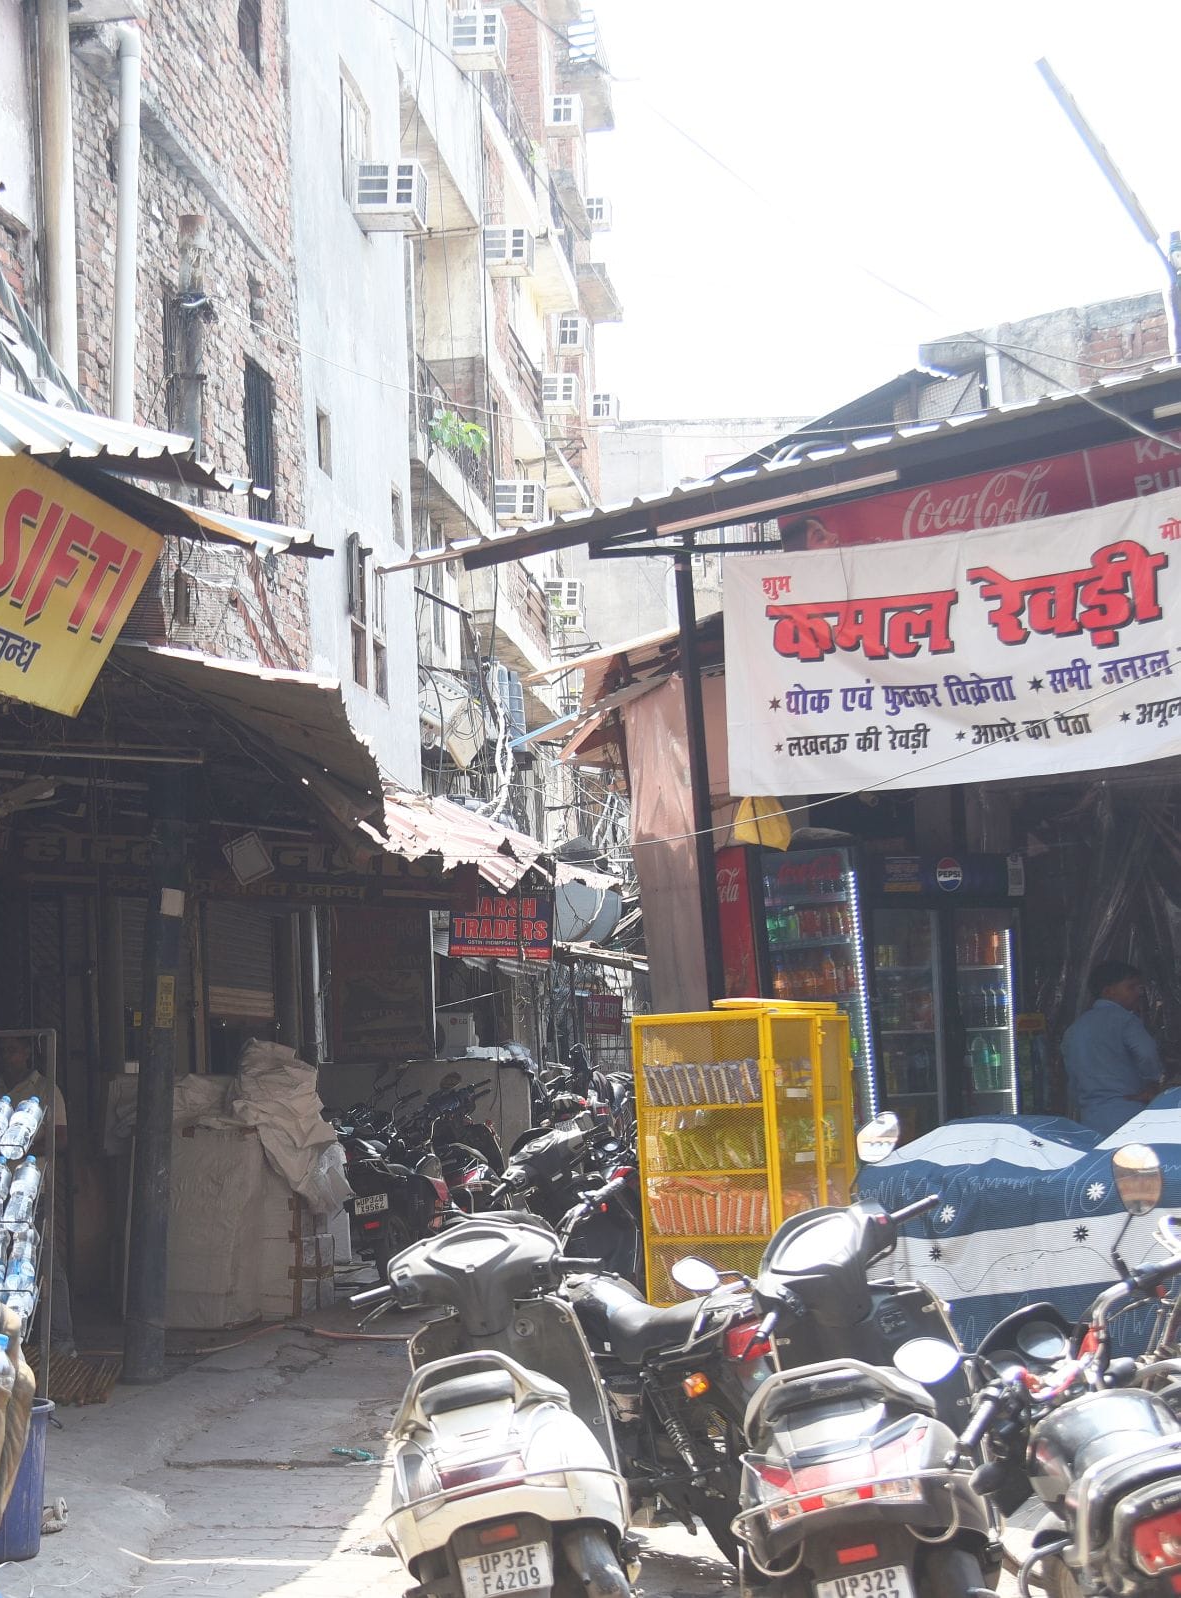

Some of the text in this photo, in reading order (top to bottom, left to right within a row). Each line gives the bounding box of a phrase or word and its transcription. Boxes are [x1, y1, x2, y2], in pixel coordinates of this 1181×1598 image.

[902, 463, 1051, 540] Coca-Cola
[765, 540, 1169, 662] कमल रेवड़ी
[840, 678, 875, 712] एवं
[944, 673, 1018, 706] विक्रेता
[1046, 658, 1092, 694] सभी
[1098, 649, 1173, 685] जनरल
[786, 732, 848, 757] लखनऊ
[855, 725, 880, 753] की
[887, 724, 930, 755] रेवड़ी
[970, 717, 1020, 745] आगरे
[1021, 717, 1050, 741] का
[937, 870, 962, 878] PEPSI
[465, 896, 537, 918] ARSH
[453, 918, 548, 940] TRADERS
[479, 1546, 536, 1574] UP32F
[482, 1566, 541, 1595] F4209
[835, 1569, 896, 1598] UP32P
